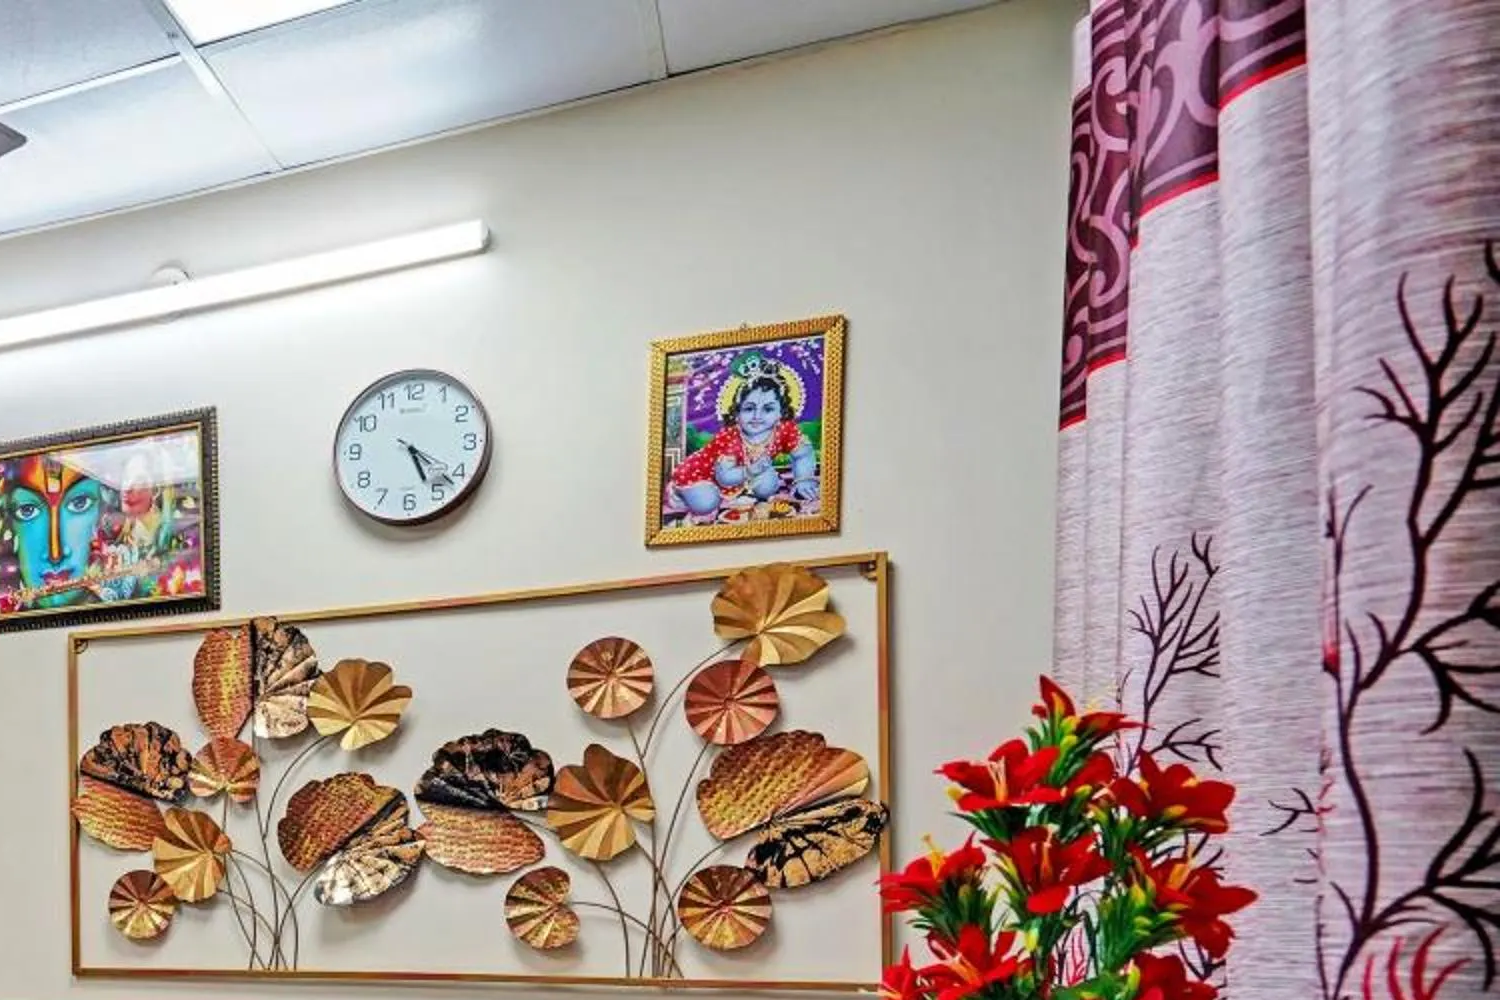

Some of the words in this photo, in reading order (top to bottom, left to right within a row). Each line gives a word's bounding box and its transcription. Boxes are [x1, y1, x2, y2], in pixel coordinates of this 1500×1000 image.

[404, 383, 425, 400] 12
[439, 385, 447, 402] 1
[378, 392, 395, 410] 11
[454, 405, 469, 423] 2
[355, 414, 377, 432] 10
[463, 433, 477, 451] 3
[349, 443, 362, 461] 9
[357, 471, 371, 488] 8
[452, 463, 465, 479] 4
[376, 488, 389, 505] 7
[431, 484, 444, 500] 5
[403, 494, 417, 511] 6
